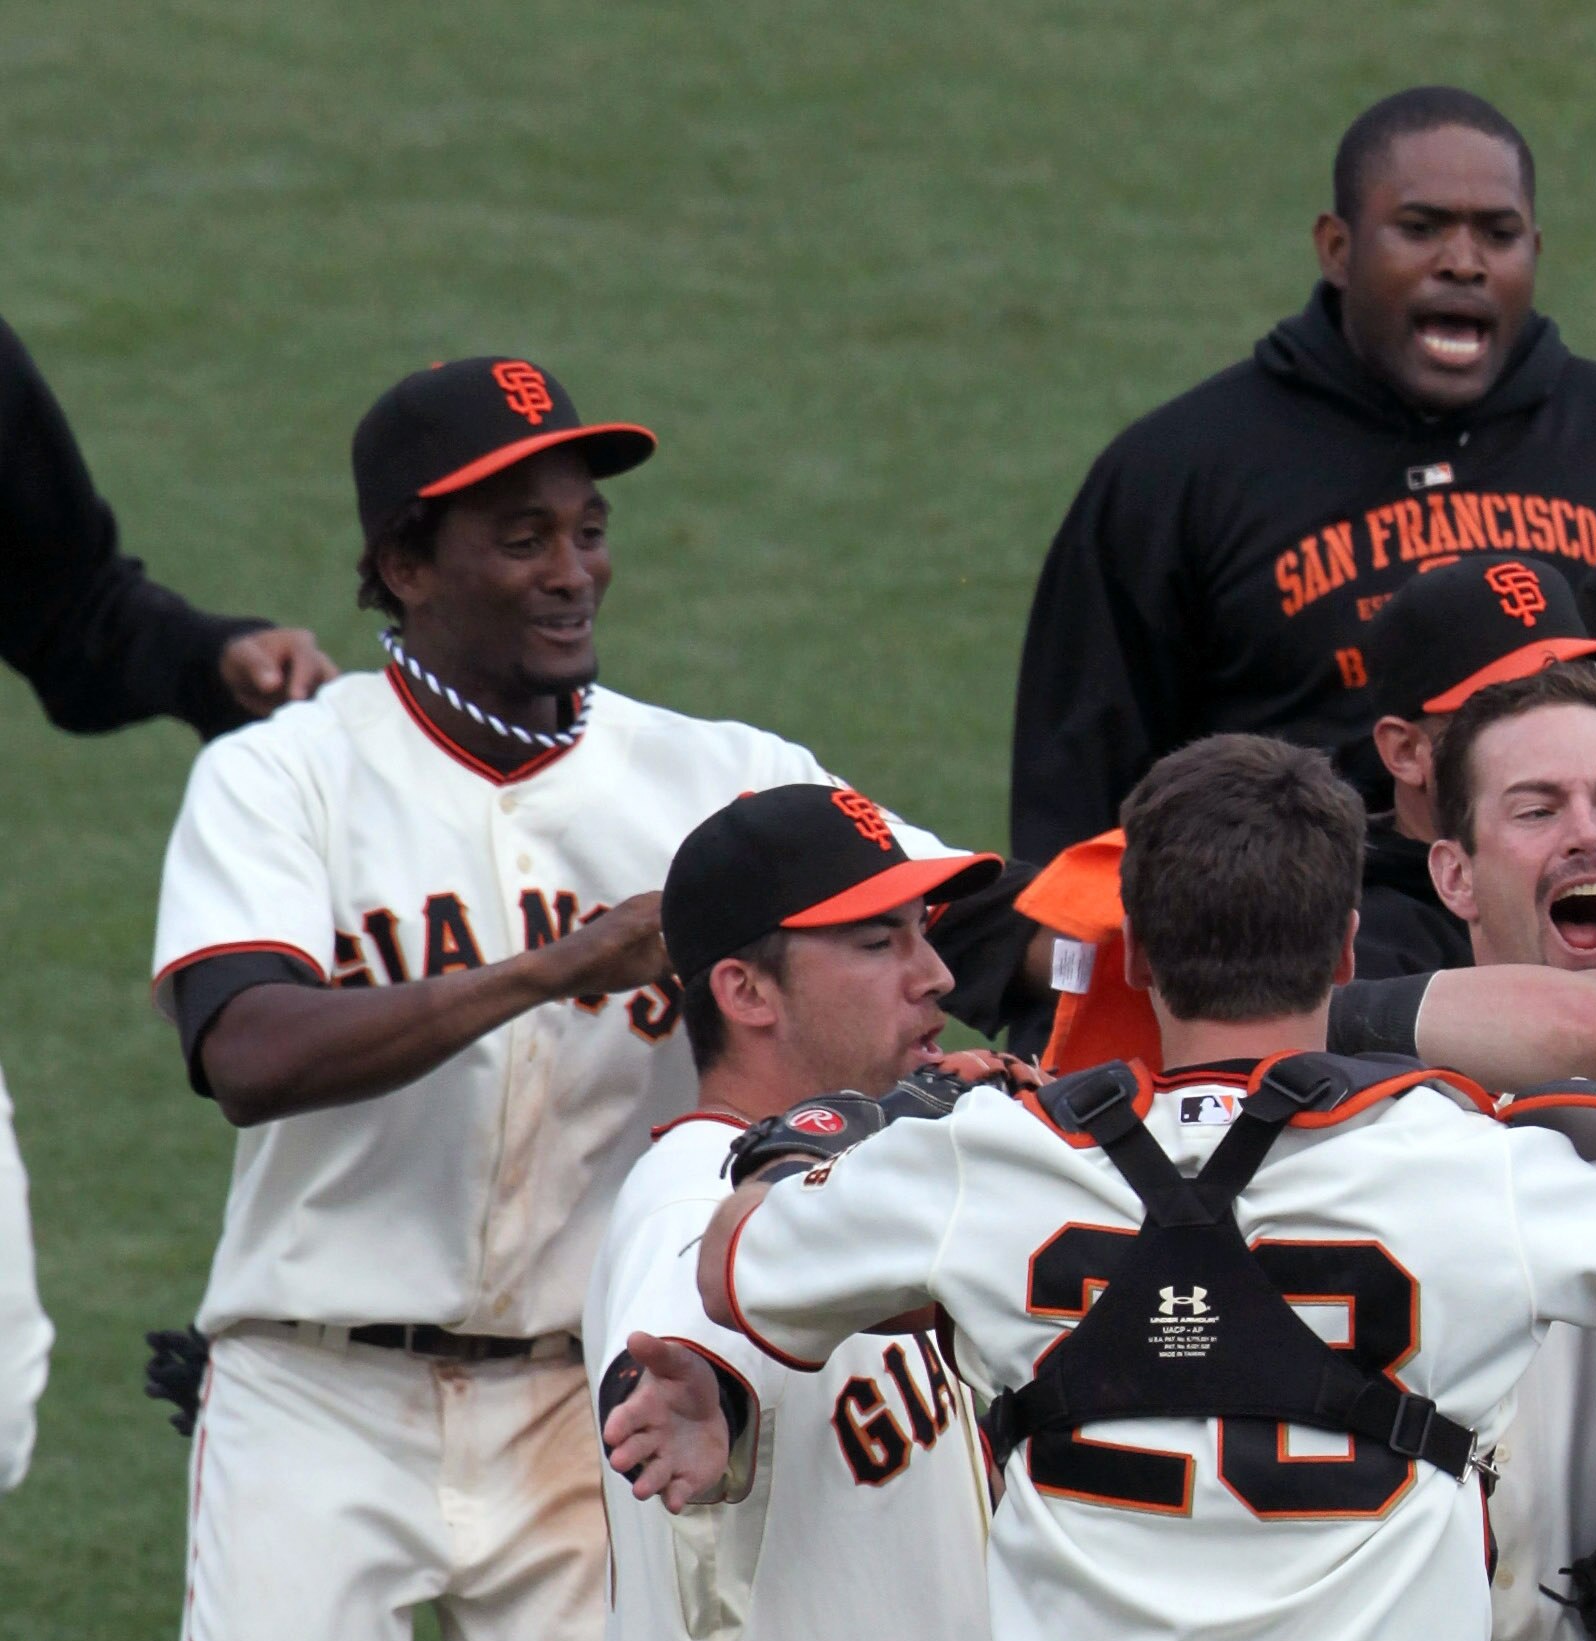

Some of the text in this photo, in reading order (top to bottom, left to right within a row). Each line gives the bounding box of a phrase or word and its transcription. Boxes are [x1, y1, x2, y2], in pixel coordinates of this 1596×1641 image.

[491, 360, 554, 425] SF
[1275, 519, 1358, 617] SAN
[1484, 560, 1547, 628] SF
[831, 788, 893, 852] SF
[1025, 1220, 1421, 1521] 28
